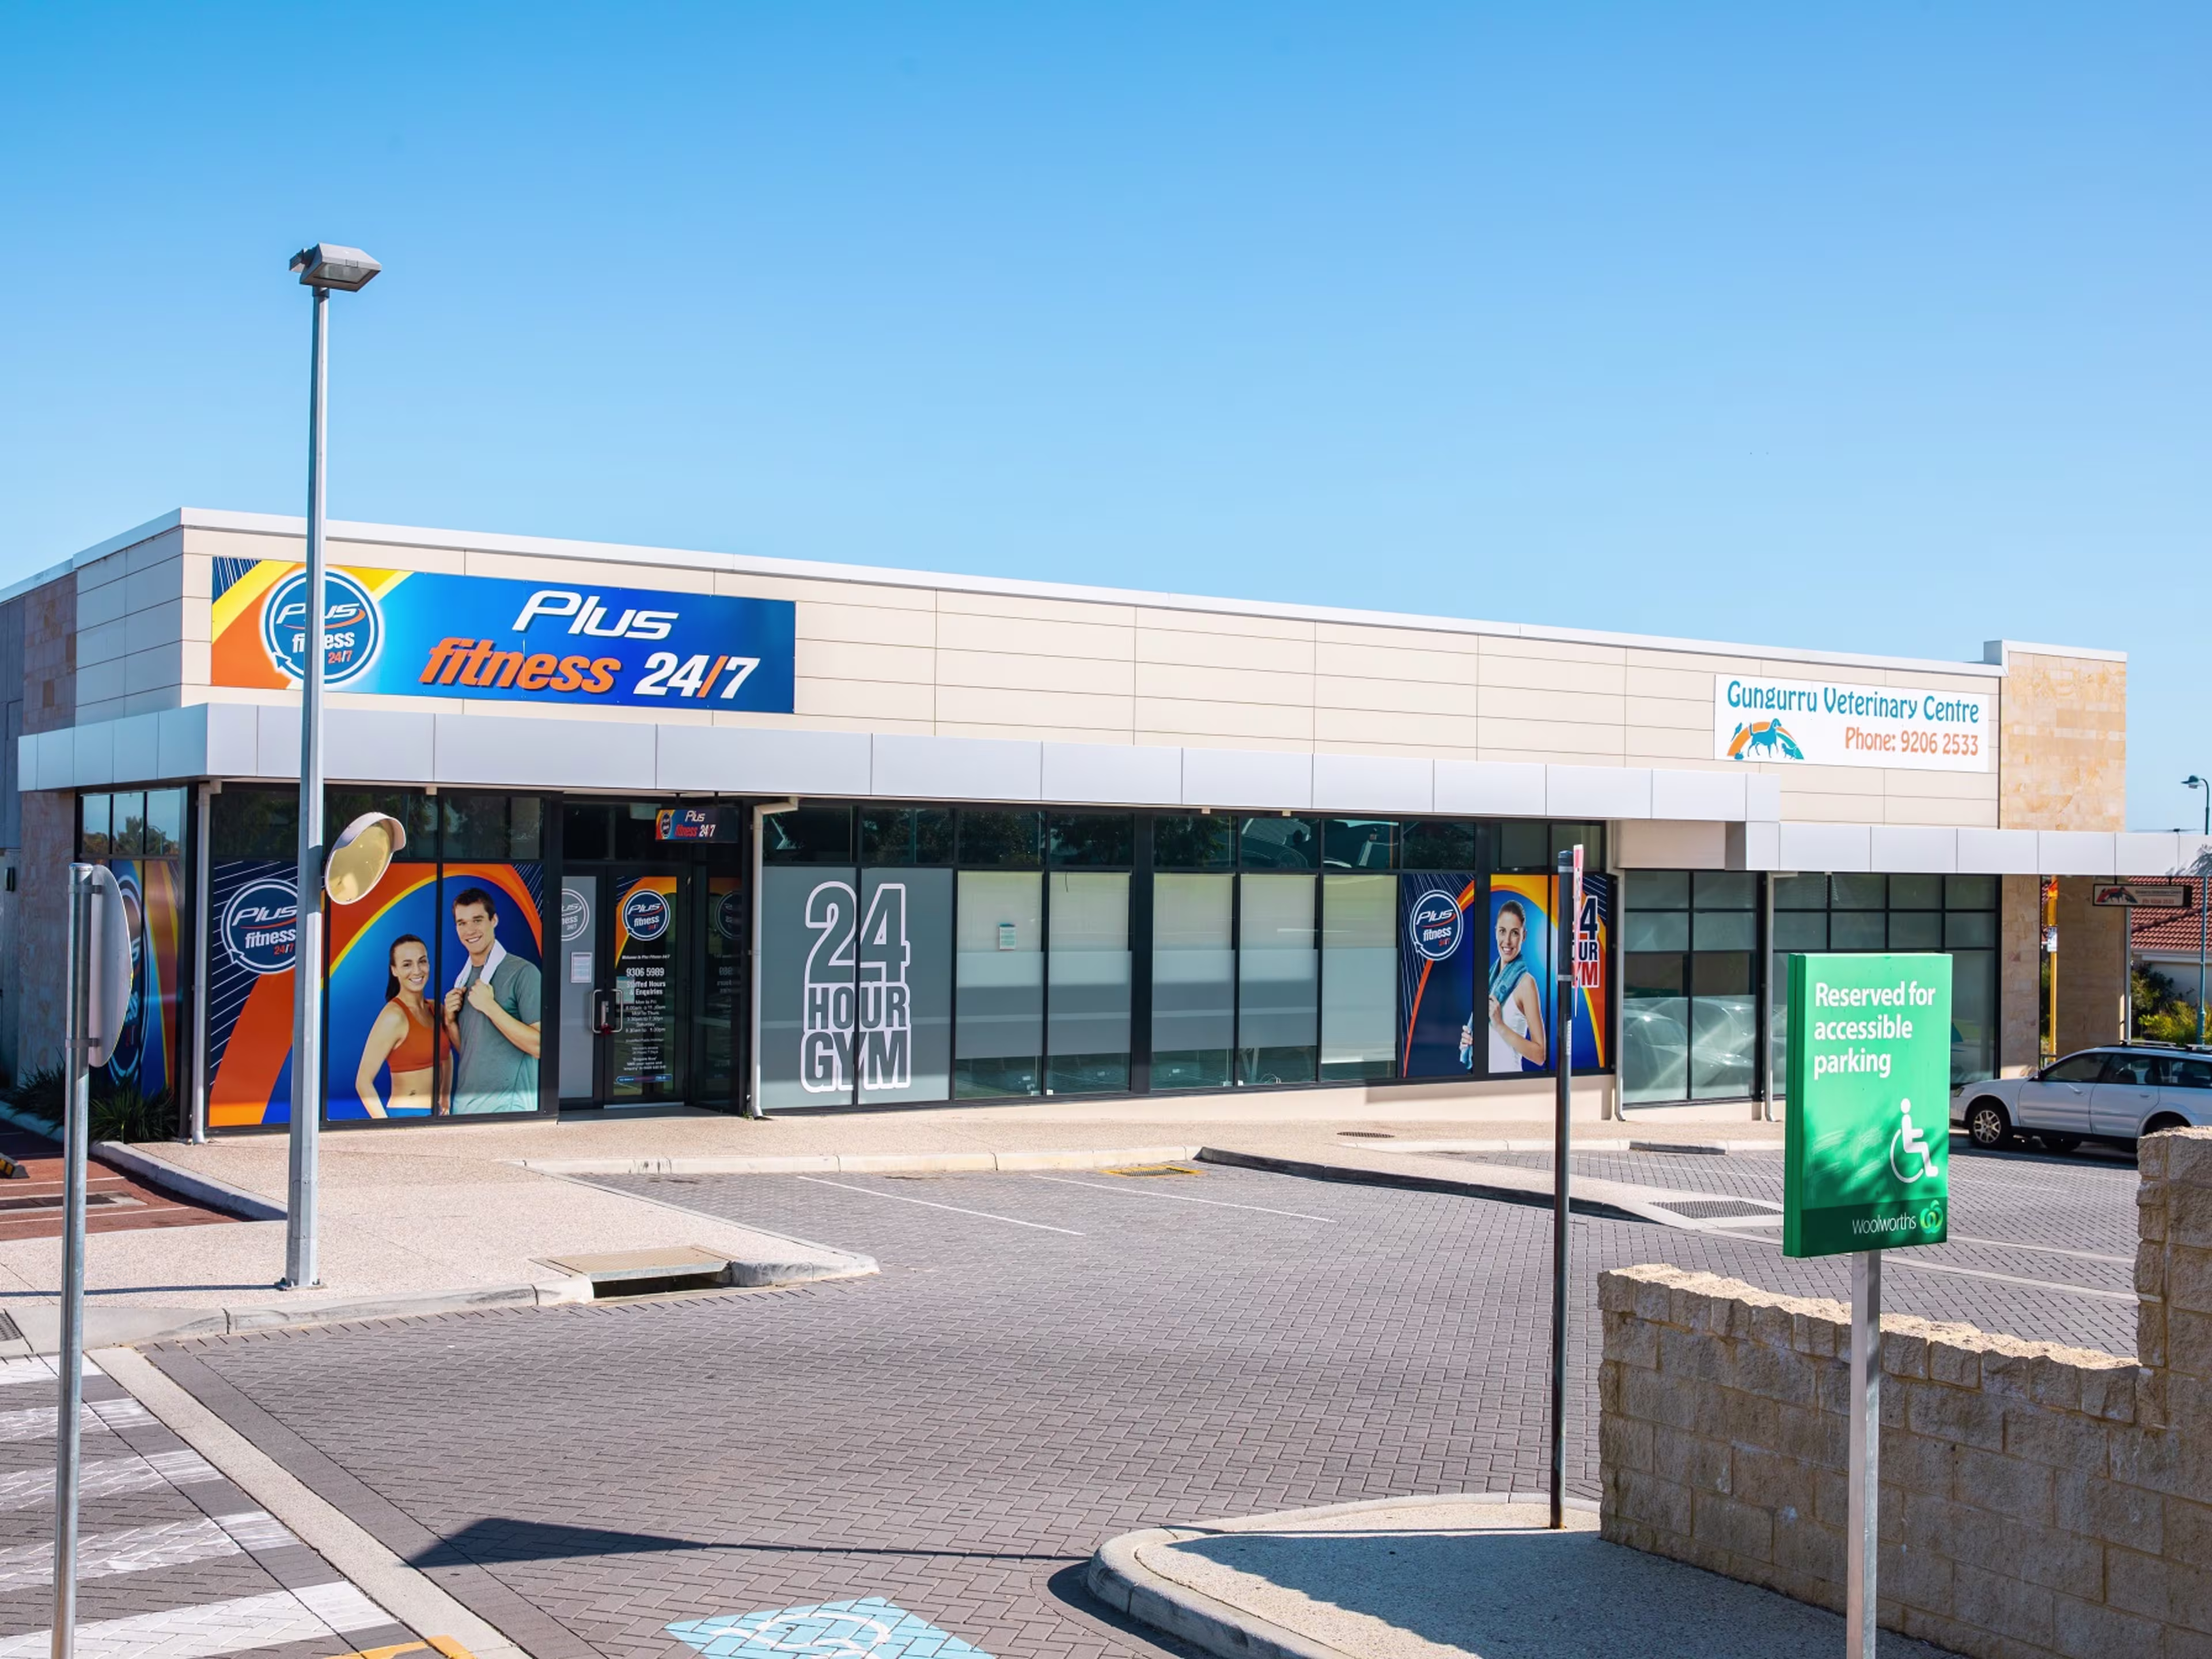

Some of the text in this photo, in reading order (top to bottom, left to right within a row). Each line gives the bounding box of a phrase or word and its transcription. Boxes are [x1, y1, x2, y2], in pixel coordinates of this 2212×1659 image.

[512, 590, 679, 639] Plus
[292, 632, 355, 653] fiess
[328, 650, 353, 664] 24/7
[418, 637, 760, 699] fitness 24/7
[1727, 680, 1979, 724] Gungurru Veterinary Centre
[1845, 726, 1978, 756] Phone: 9206 2533
[232, 906, 297, 926] Plus
[628, 903, 661, 915] Plus
[1416, 910, 1454, 925] Plus
[245, 929, 296, 949] fitness
[805, 881, 911, 984] 24
[1423, 927, 1452, 942] fitness
[274, 943, 295, 956] 24/7
[626, 967, 645, 977] 9306
[1815, 980, 1936, 1007] Reserved for
[804, 982, 911, 1032] HOUR
[1815, 1014, 1913, 1040] accessible
[801, 1029, 911, 1093] GYM
[1814, 1047, 1891, 1081] parking
